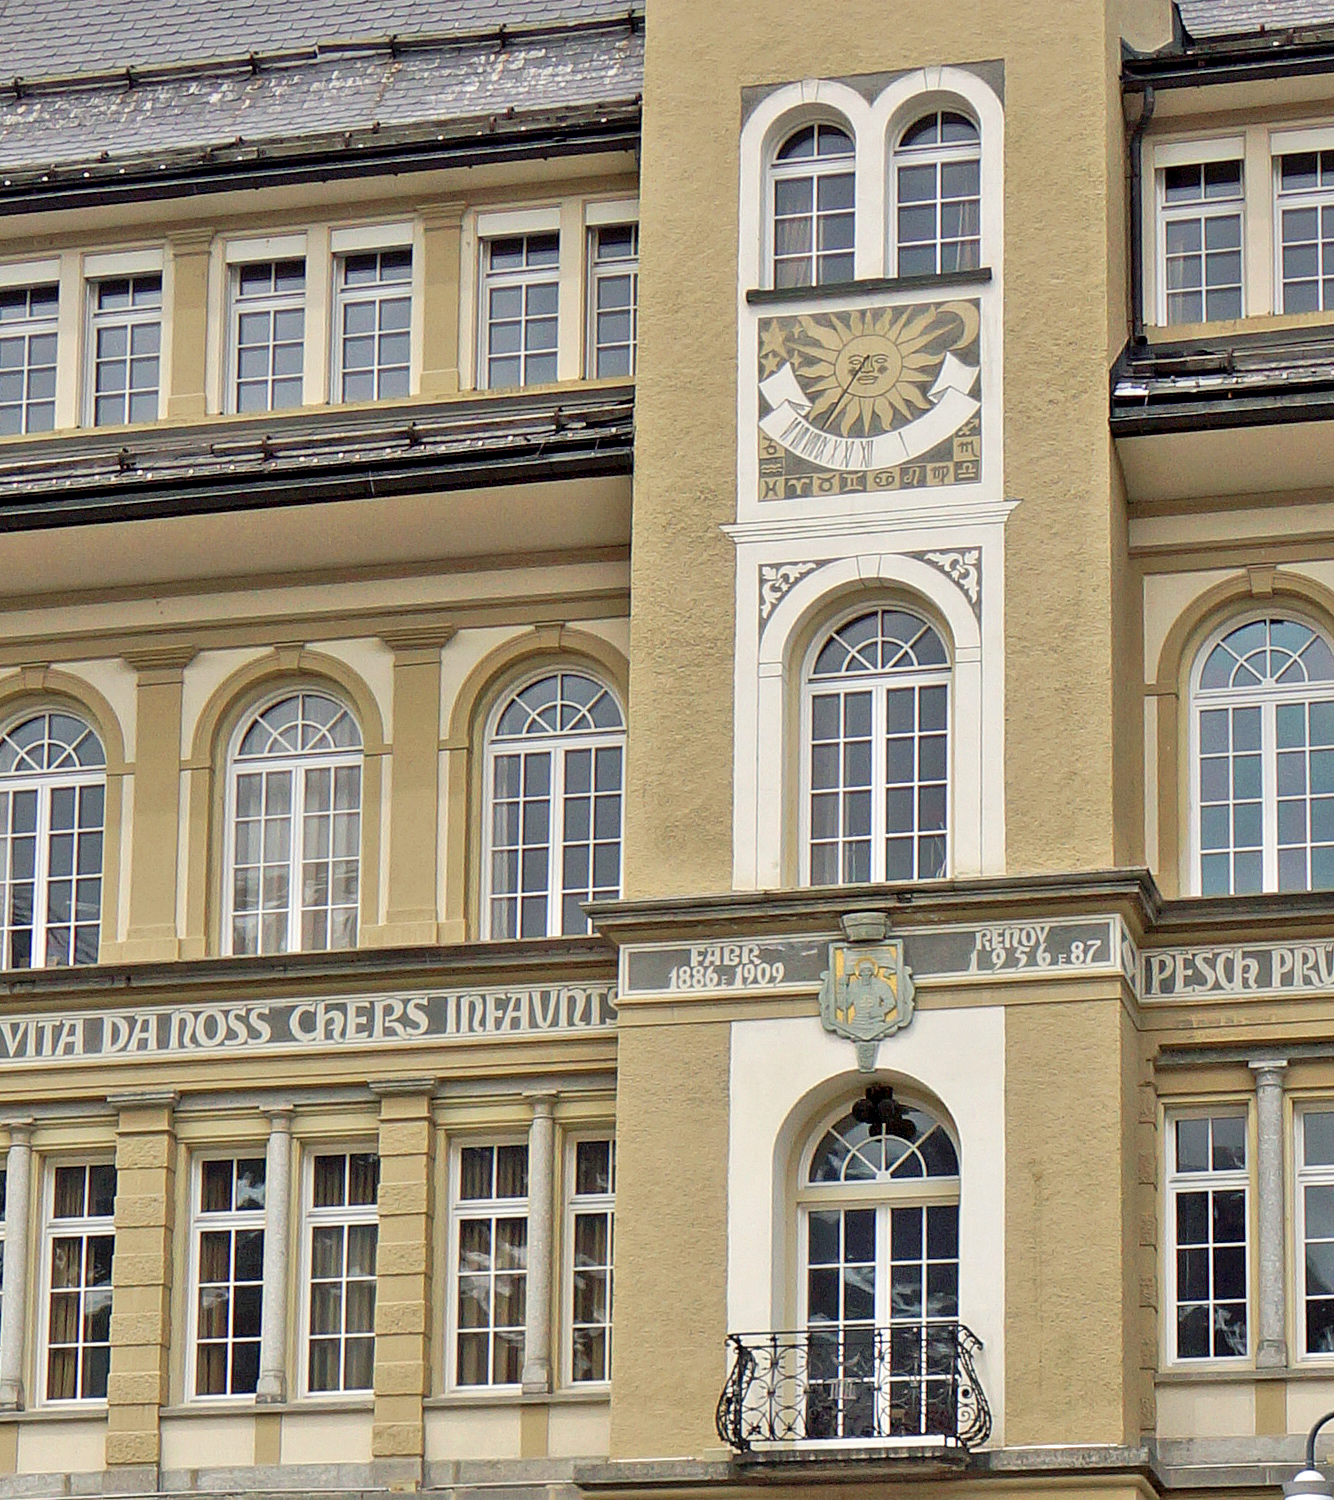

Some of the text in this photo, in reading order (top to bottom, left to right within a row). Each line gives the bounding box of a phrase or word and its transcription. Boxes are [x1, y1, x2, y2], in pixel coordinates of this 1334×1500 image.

[976, 925, 1050, 951] RENOV
[690, 944, 762, 967] FABR
[1058, 953, 1067, 966] E
[1070, 940, 1102, 966] 87
[668, 962, 784, 990] 1886 E 1909
[1151, 947, 1258, 995] PESCH
[101, 1013, 158, 1054] DA
[169, 1004, 273, 1051] NOSS
[288, 994, 431, 1044] CHERS
